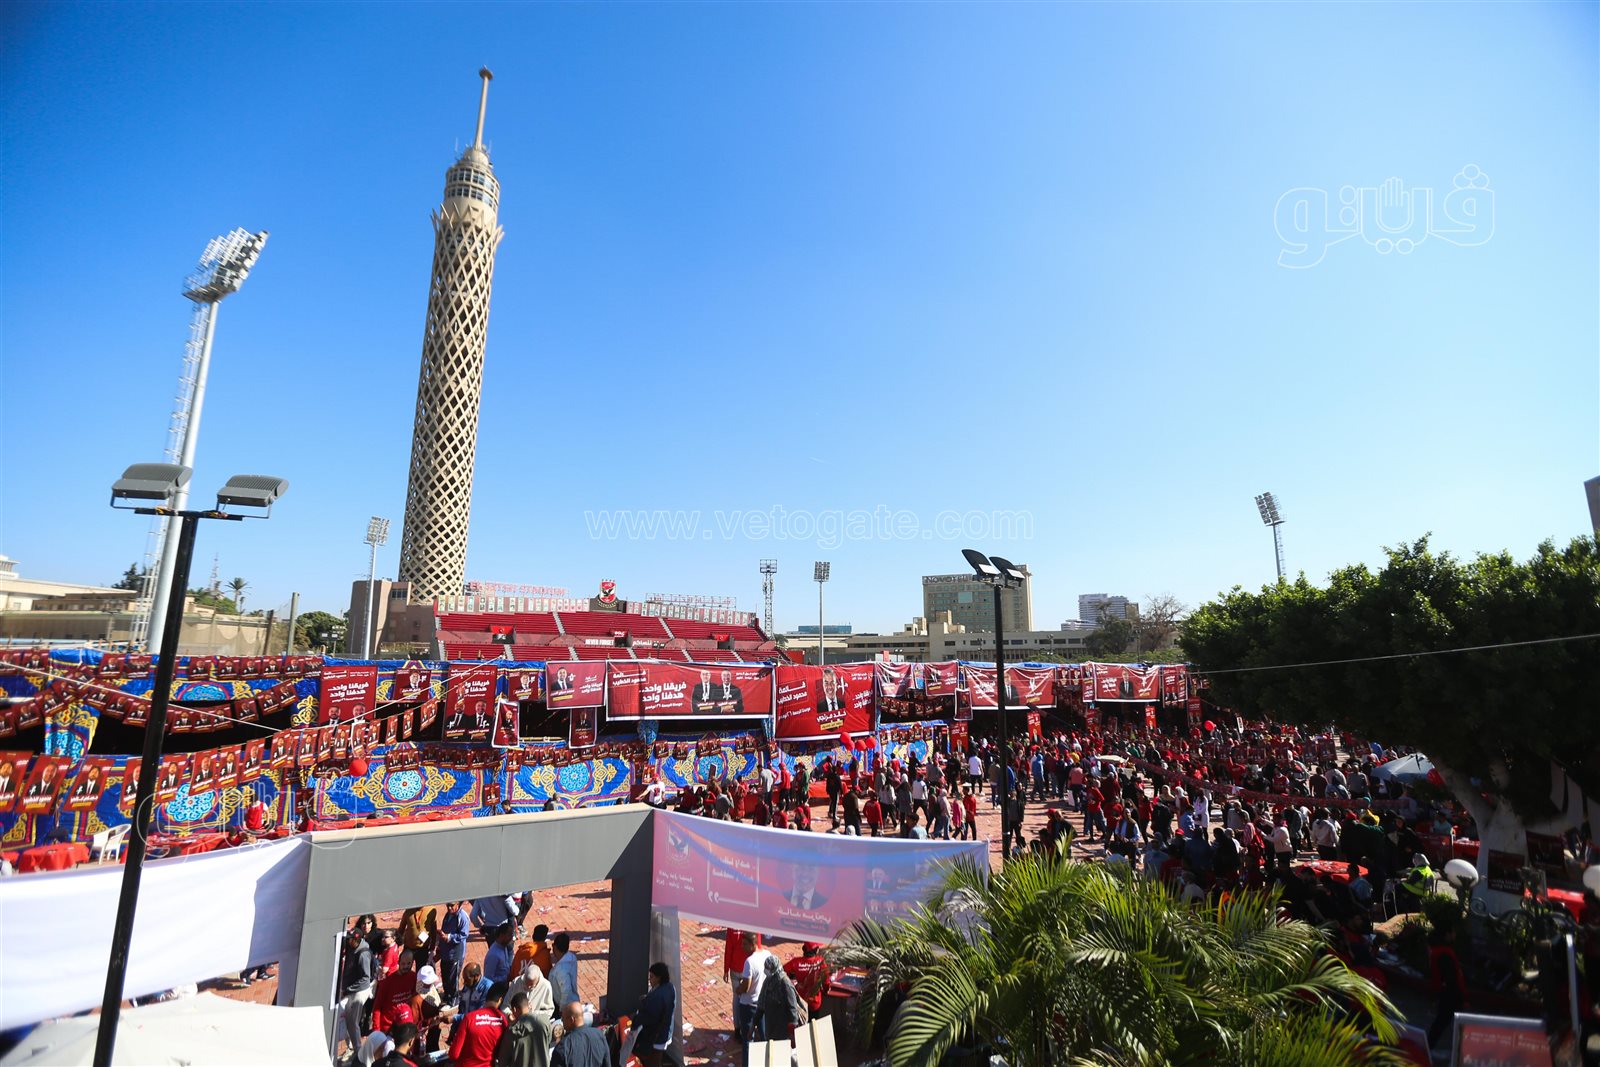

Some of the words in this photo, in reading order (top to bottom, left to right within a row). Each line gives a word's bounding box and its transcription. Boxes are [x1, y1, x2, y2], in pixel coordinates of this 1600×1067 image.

[663, 682, 687, 692] فريقنا
[642, 693, 660, 703] واحد
[662, 692, 684, 700] هدفنا
[833, 711, 847, 719] خالد
